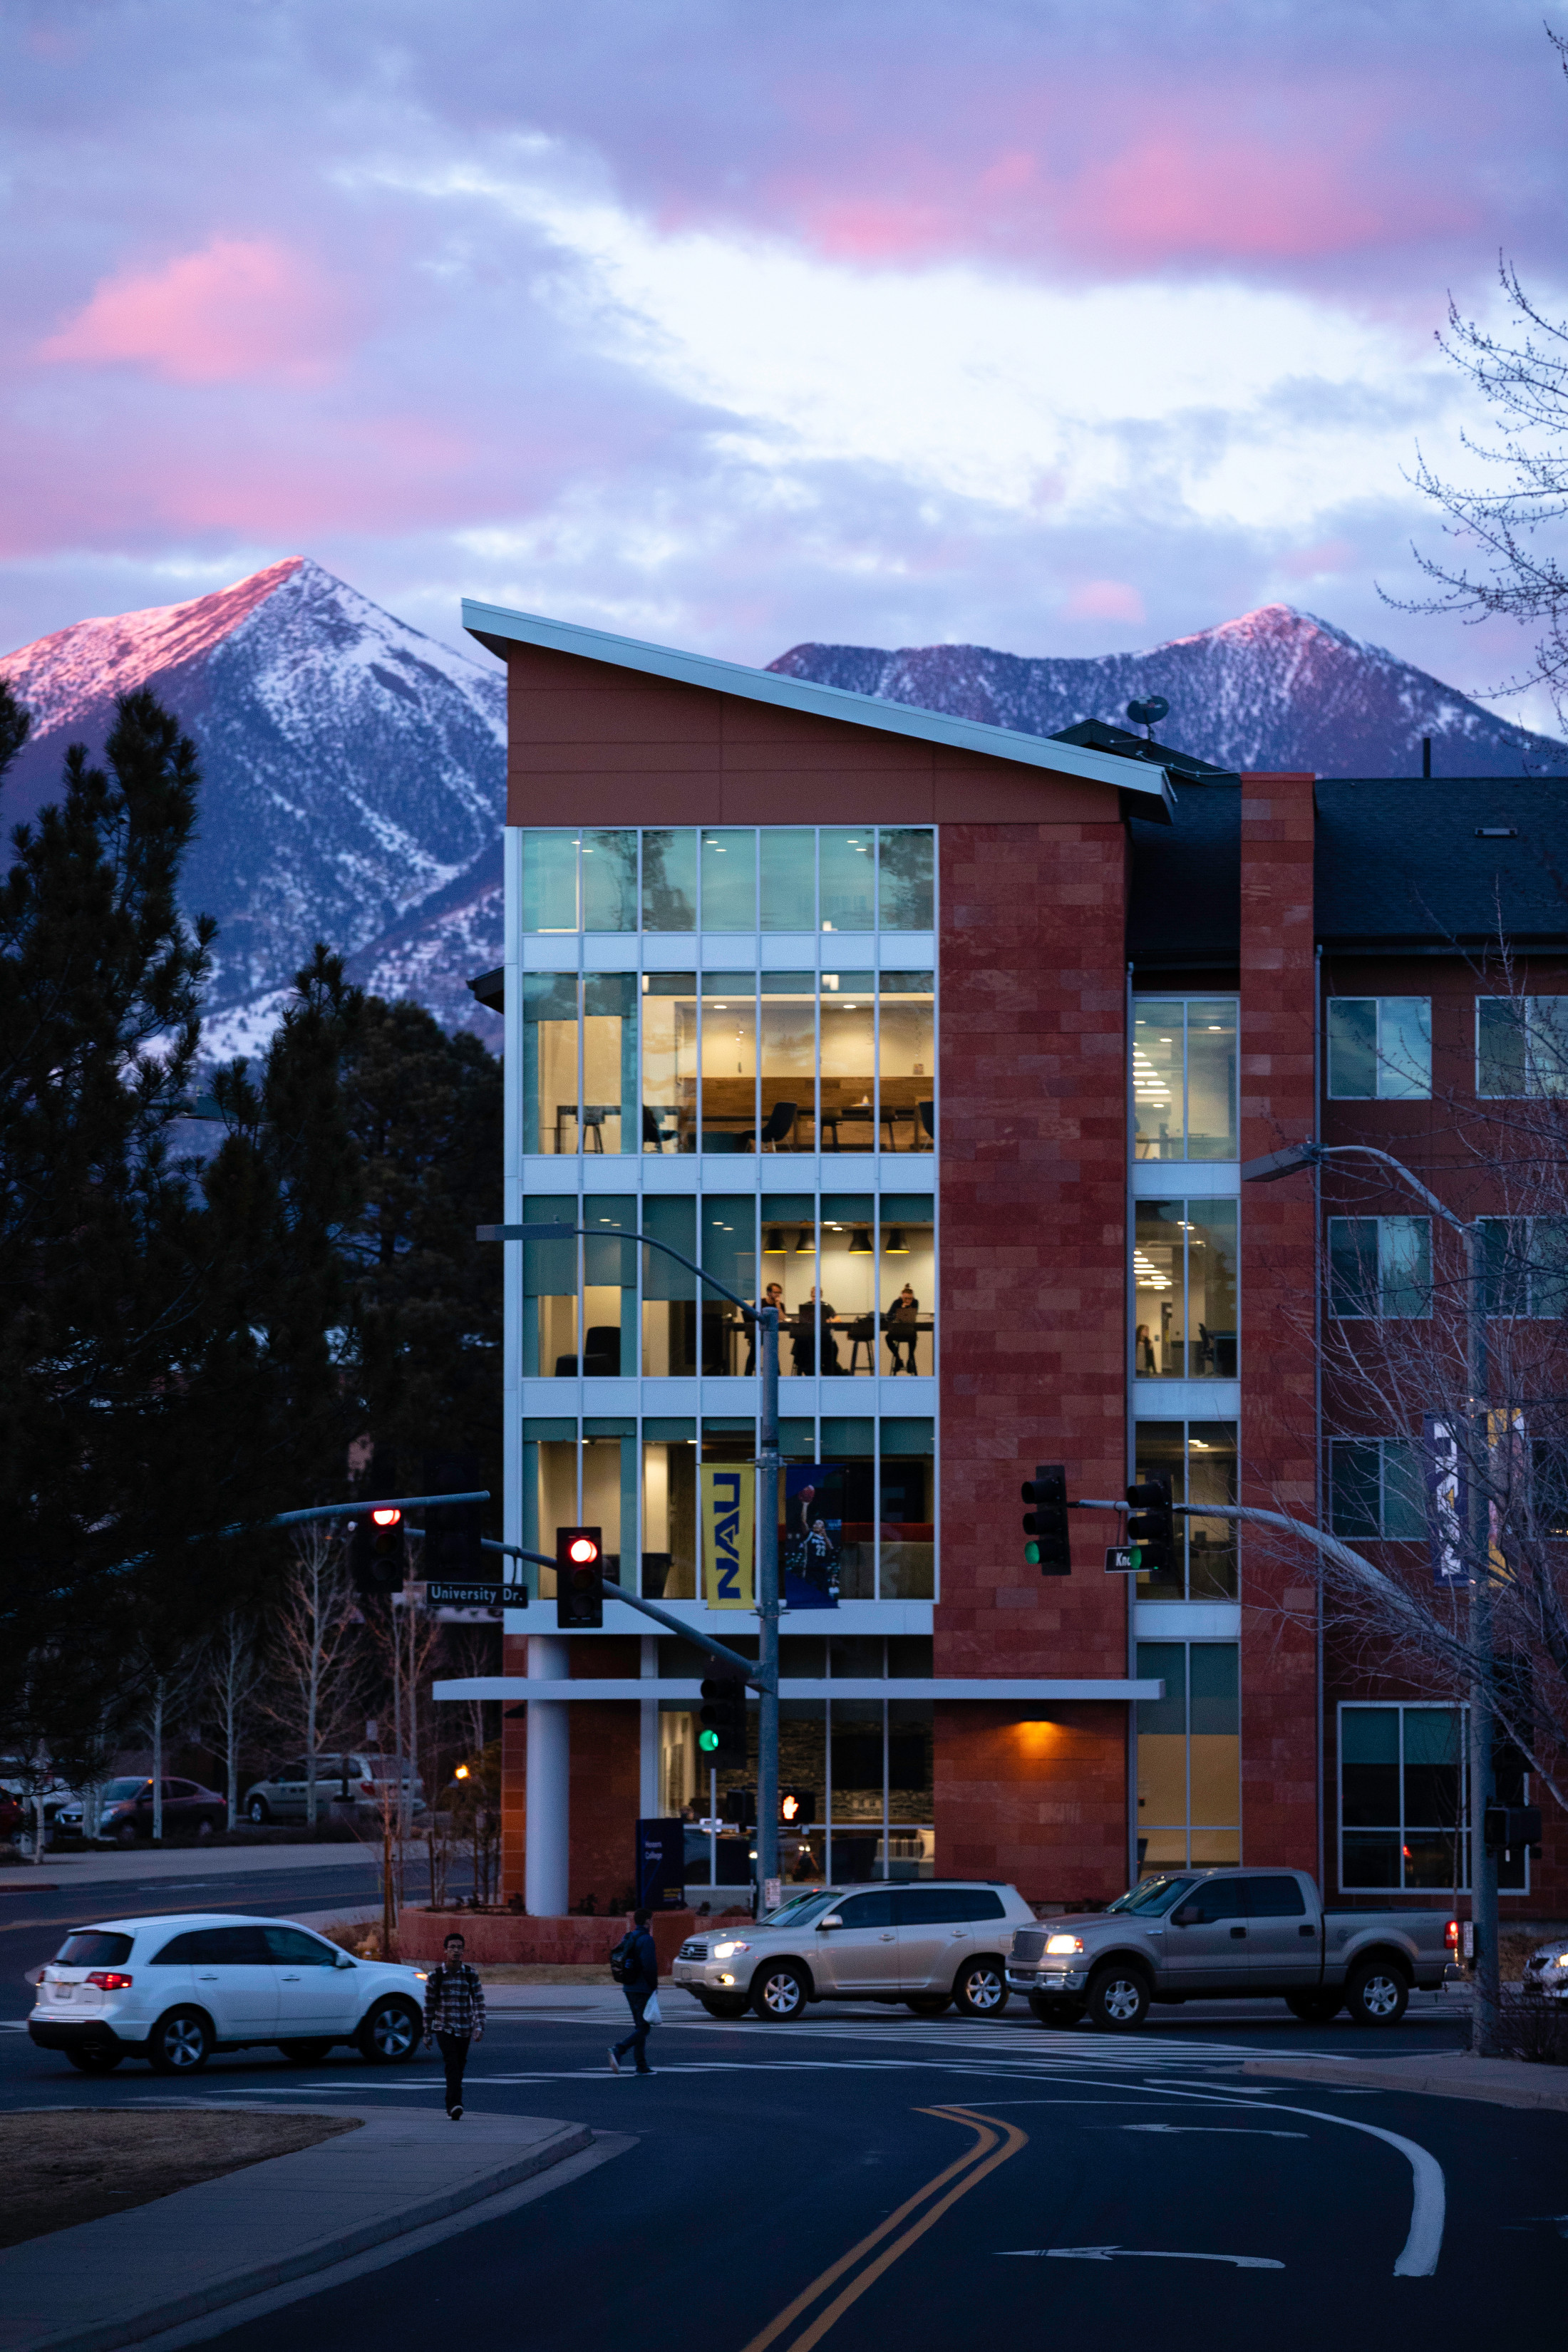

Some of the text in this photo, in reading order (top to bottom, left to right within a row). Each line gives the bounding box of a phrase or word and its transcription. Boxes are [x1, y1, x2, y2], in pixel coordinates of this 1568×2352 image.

[713, 1473, 741, 1599] NAU
[430, 1585, 524, 1604] University Dr.
